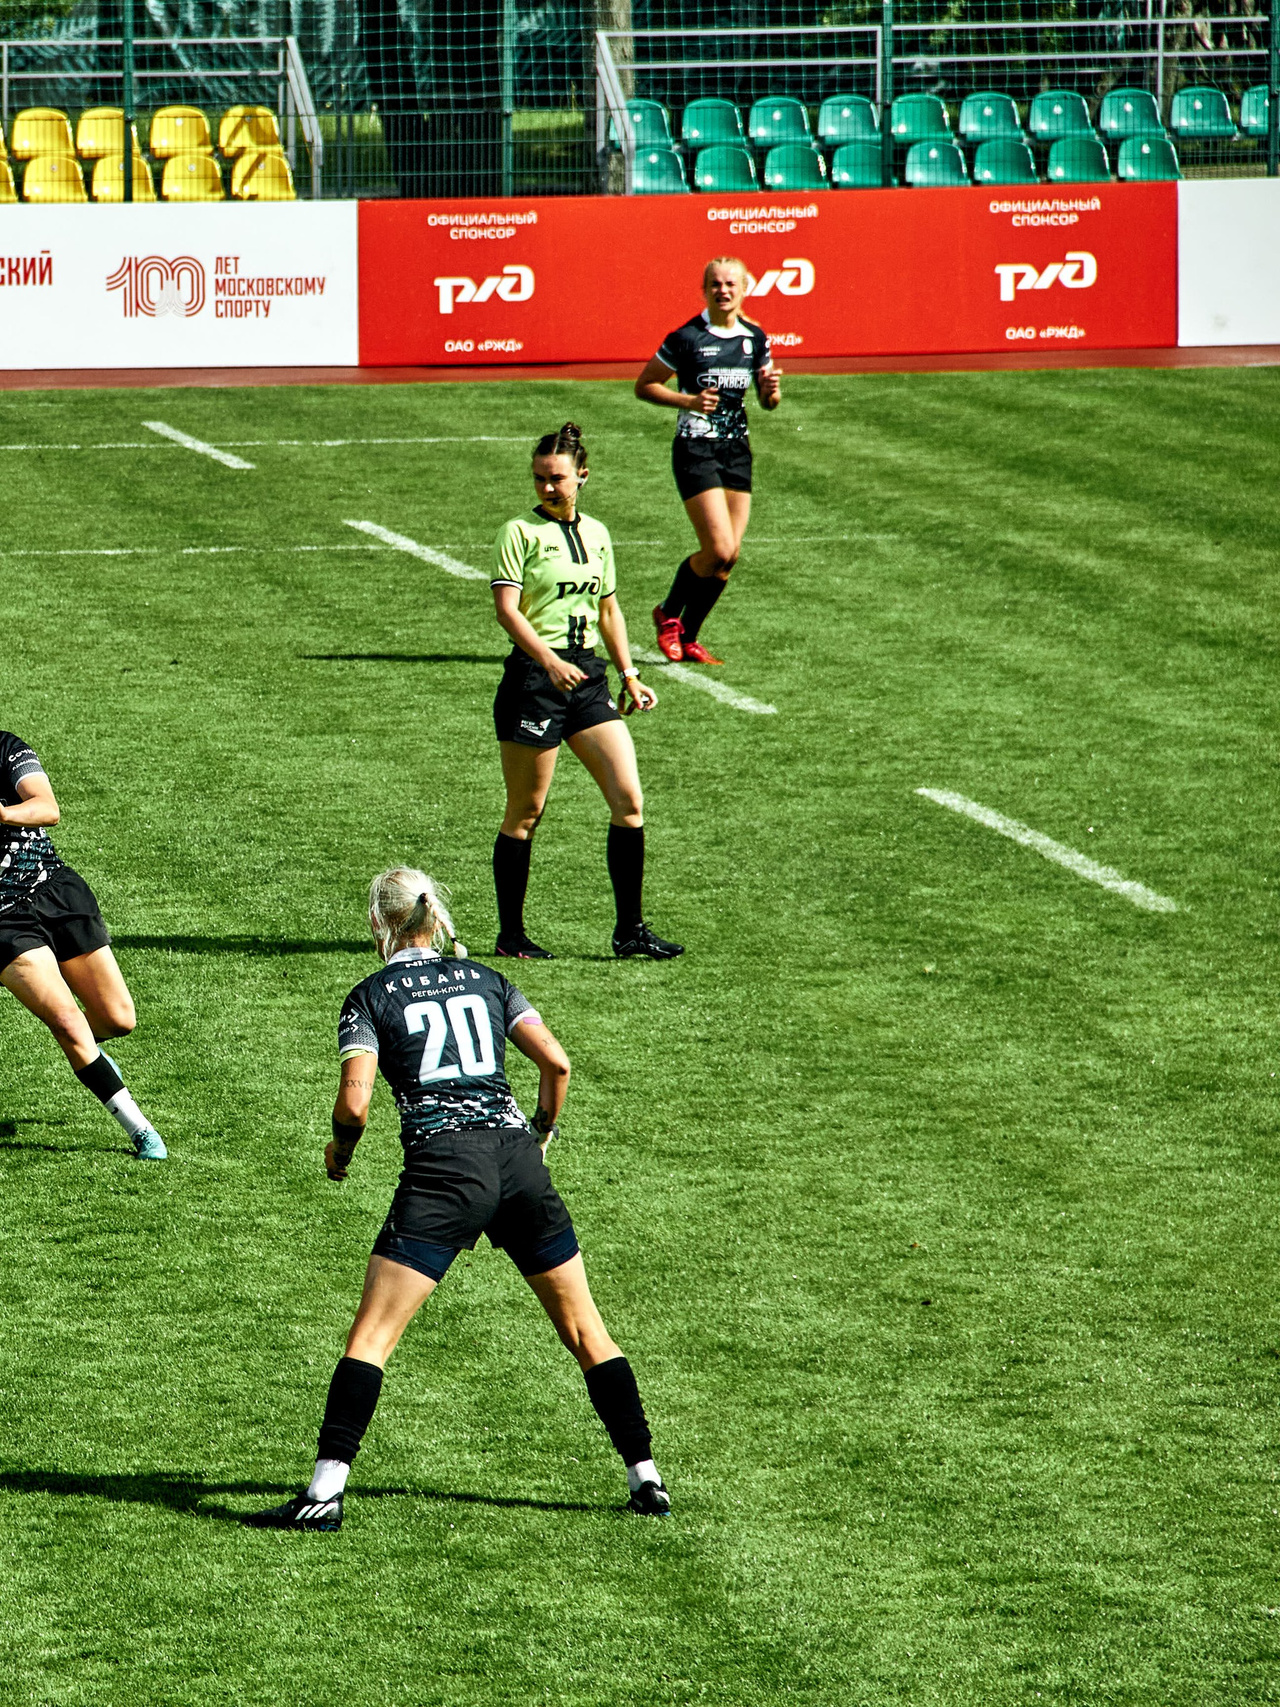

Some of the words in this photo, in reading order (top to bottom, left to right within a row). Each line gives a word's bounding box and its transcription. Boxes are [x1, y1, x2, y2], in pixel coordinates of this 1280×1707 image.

[707, 203, 819, 221] ОФИЦИАЛЬНЫЙ
[989, 196, 1101, 214] ОФИЦИАЛЬНЫЙ
[427, 210, 538, 227] ОФИЦИАЛЬНЫЙ
[1012, 213, 1079, 227] СПОНСОР
[449, 227, 517, 240] СПОНСОР
[730, 220, 797, 235] СПОНСОР
[214, 256, 241, 275] ЛЕТ
[105, 255, 206, 318] 100
[214, 276, 326, 297] МОСКОВСКОМУ
[214, 299, 272, 319] СПОРТУ
[1005, 327, 1036, 341] ОАО
[444, 341, 474, 353] ОАО
[411, 984, 466, 999] РЕГБИ-КЛУБ
[403, 993, 497, 1085] 20
